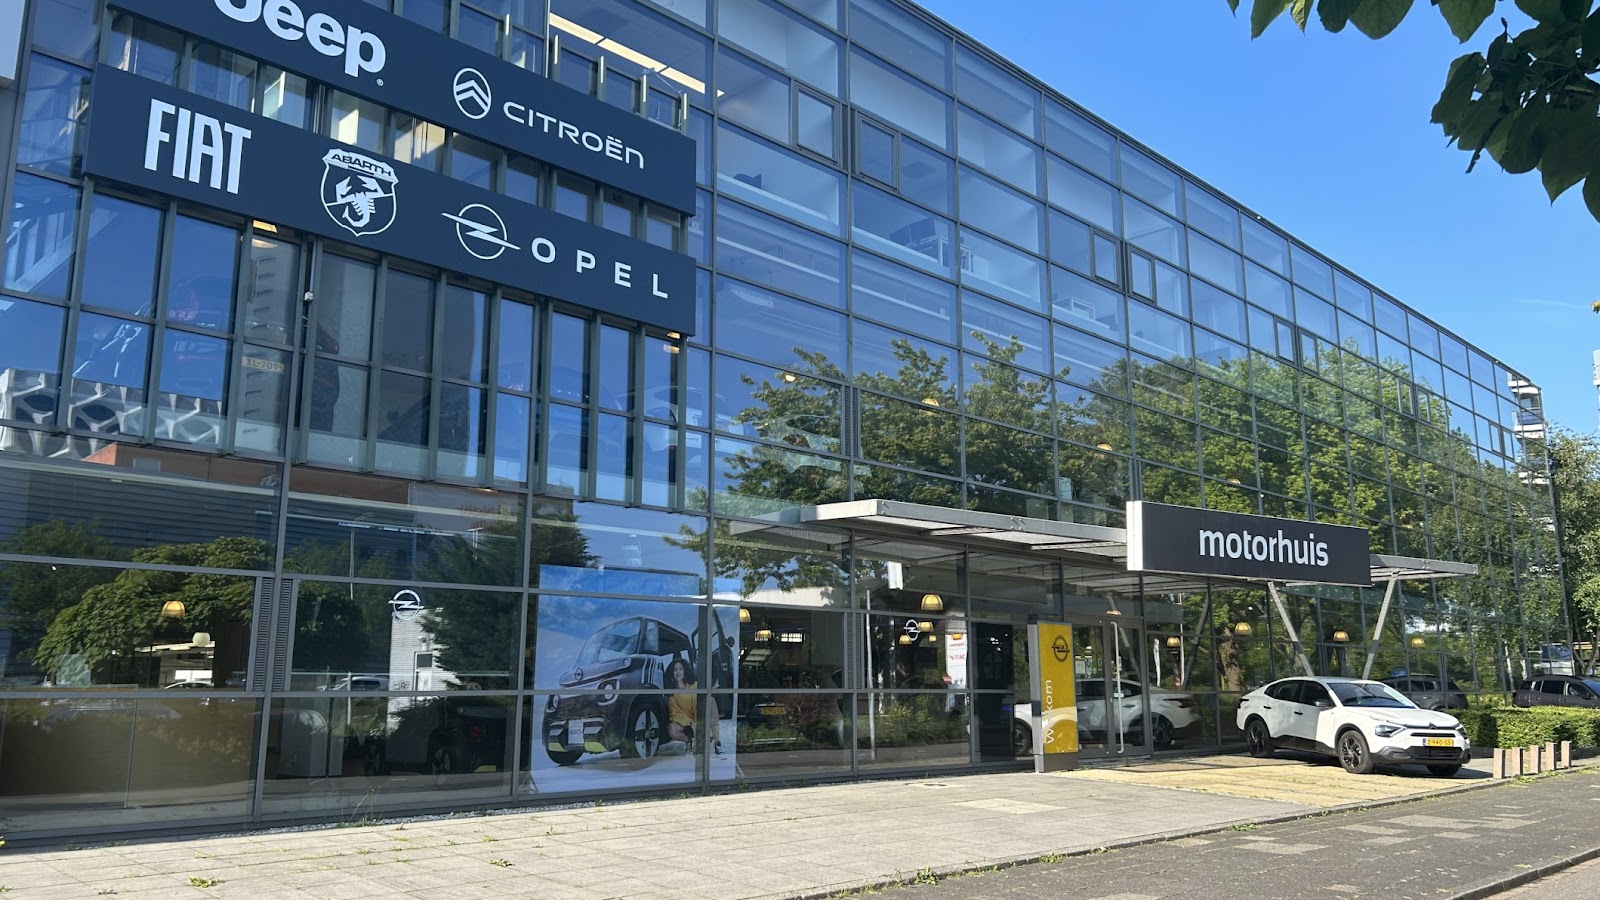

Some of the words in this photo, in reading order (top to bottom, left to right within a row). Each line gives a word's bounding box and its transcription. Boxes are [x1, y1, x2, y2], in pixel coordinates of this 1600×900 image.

[144, 98, 252, 194] FIAT
[331, 153, 391, 177] ABARTH
[503, 101, 644, 169] CITROËN
[531, 237, 668, 299] OPEL
[1199, 529, 1329, 567] motorhuis
[1045, 679, 1055, 744] Wkom
